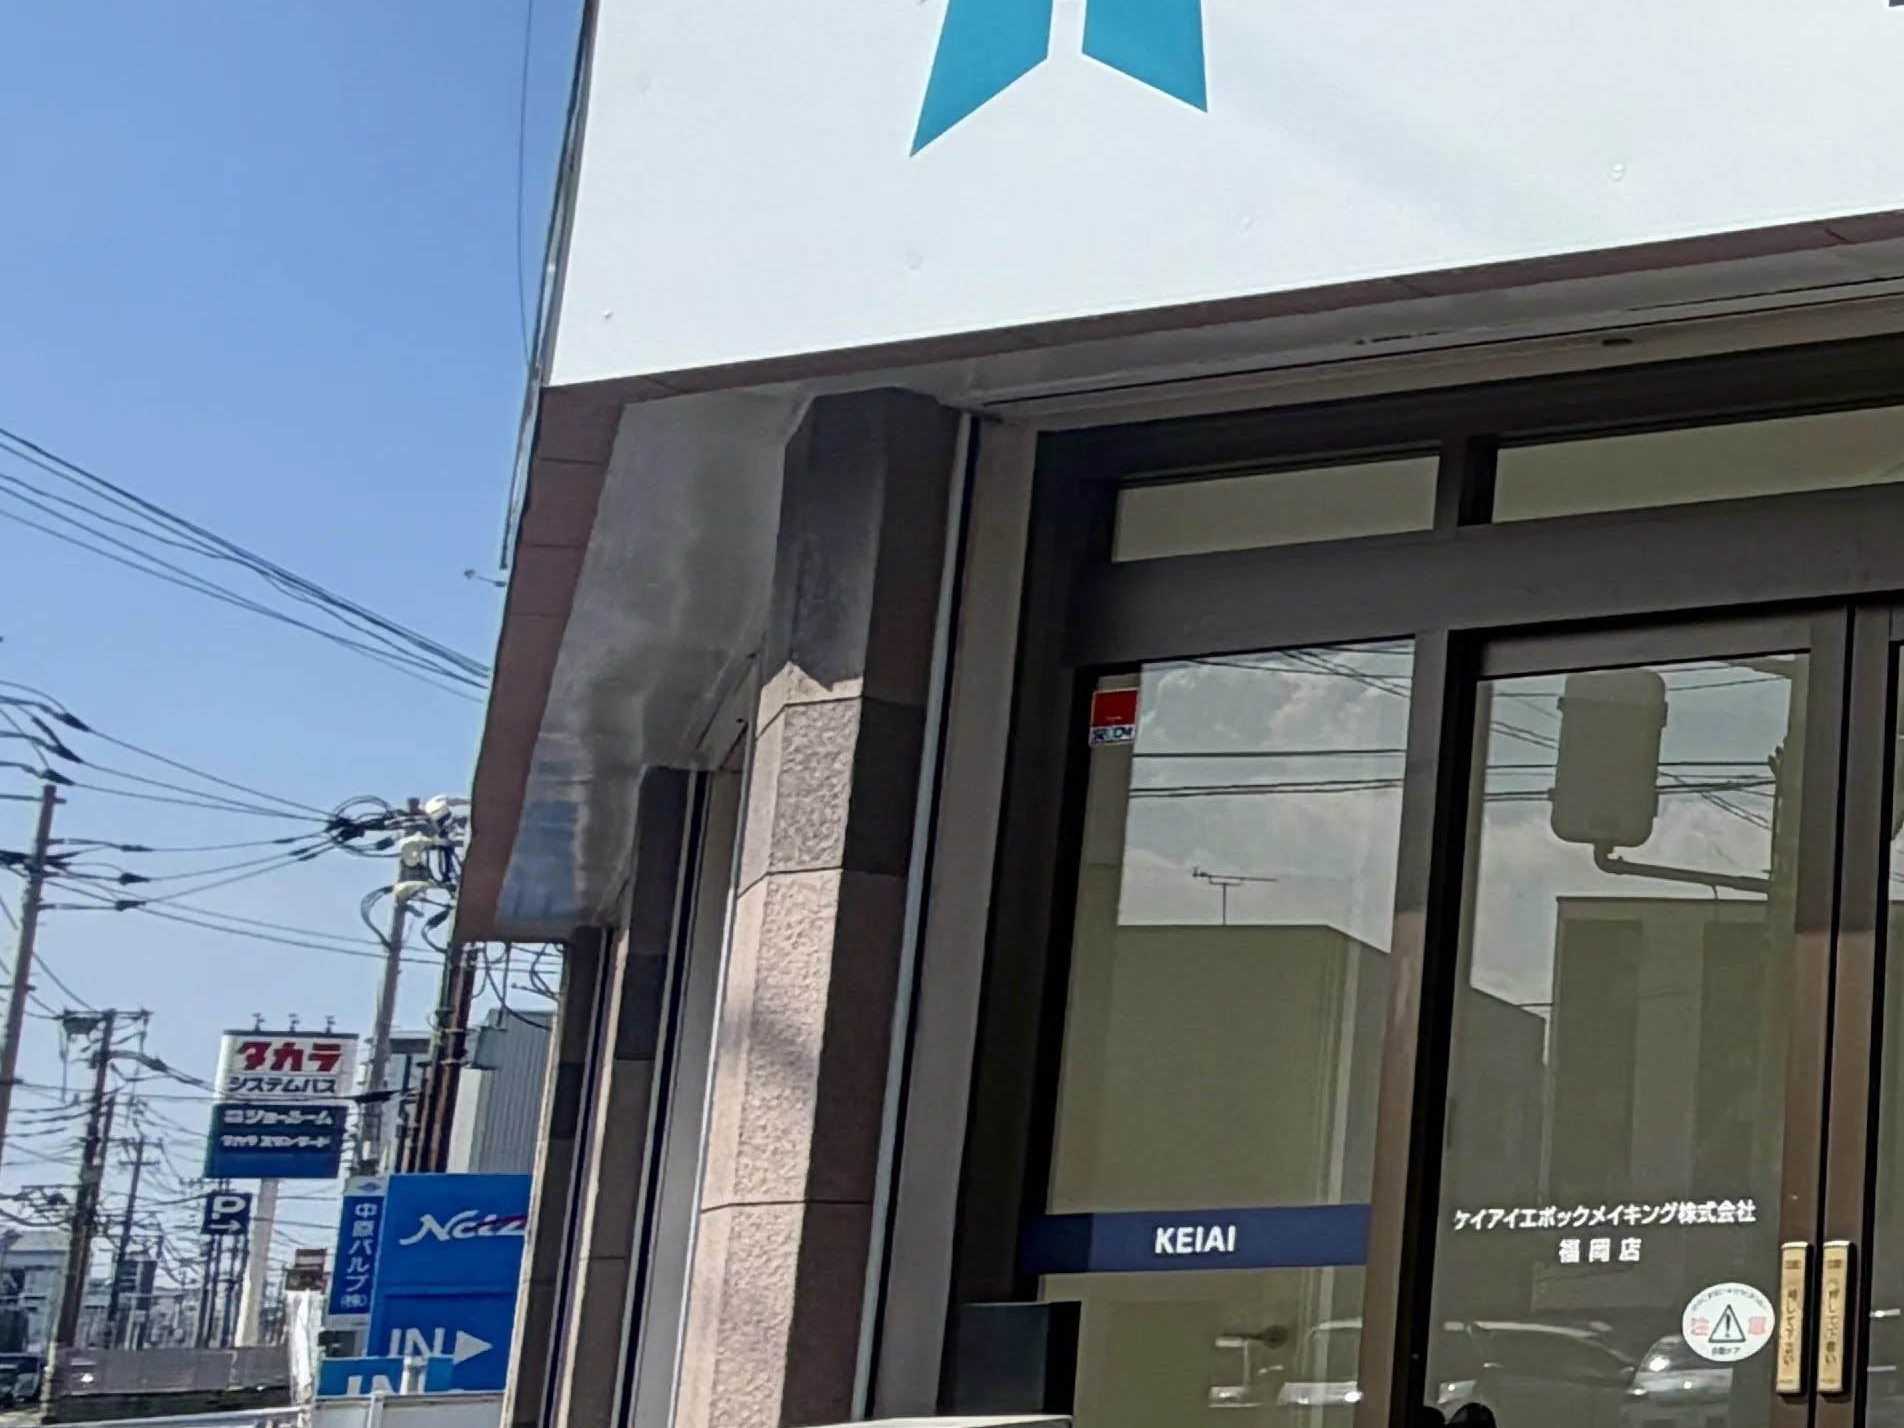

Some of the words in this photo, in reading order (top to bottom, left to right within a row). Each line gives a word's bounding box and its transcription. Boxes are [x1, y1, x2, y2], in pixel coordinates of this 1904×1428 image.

[237, 1041, 342, 1072] タカラ
[227, 1076, 336, 1093] システムバス
[212, 1196, 246, 1220] P
[1154, 1226, 1237, 1255] KEIAI
[387, 1327, 446, 1358] IN
